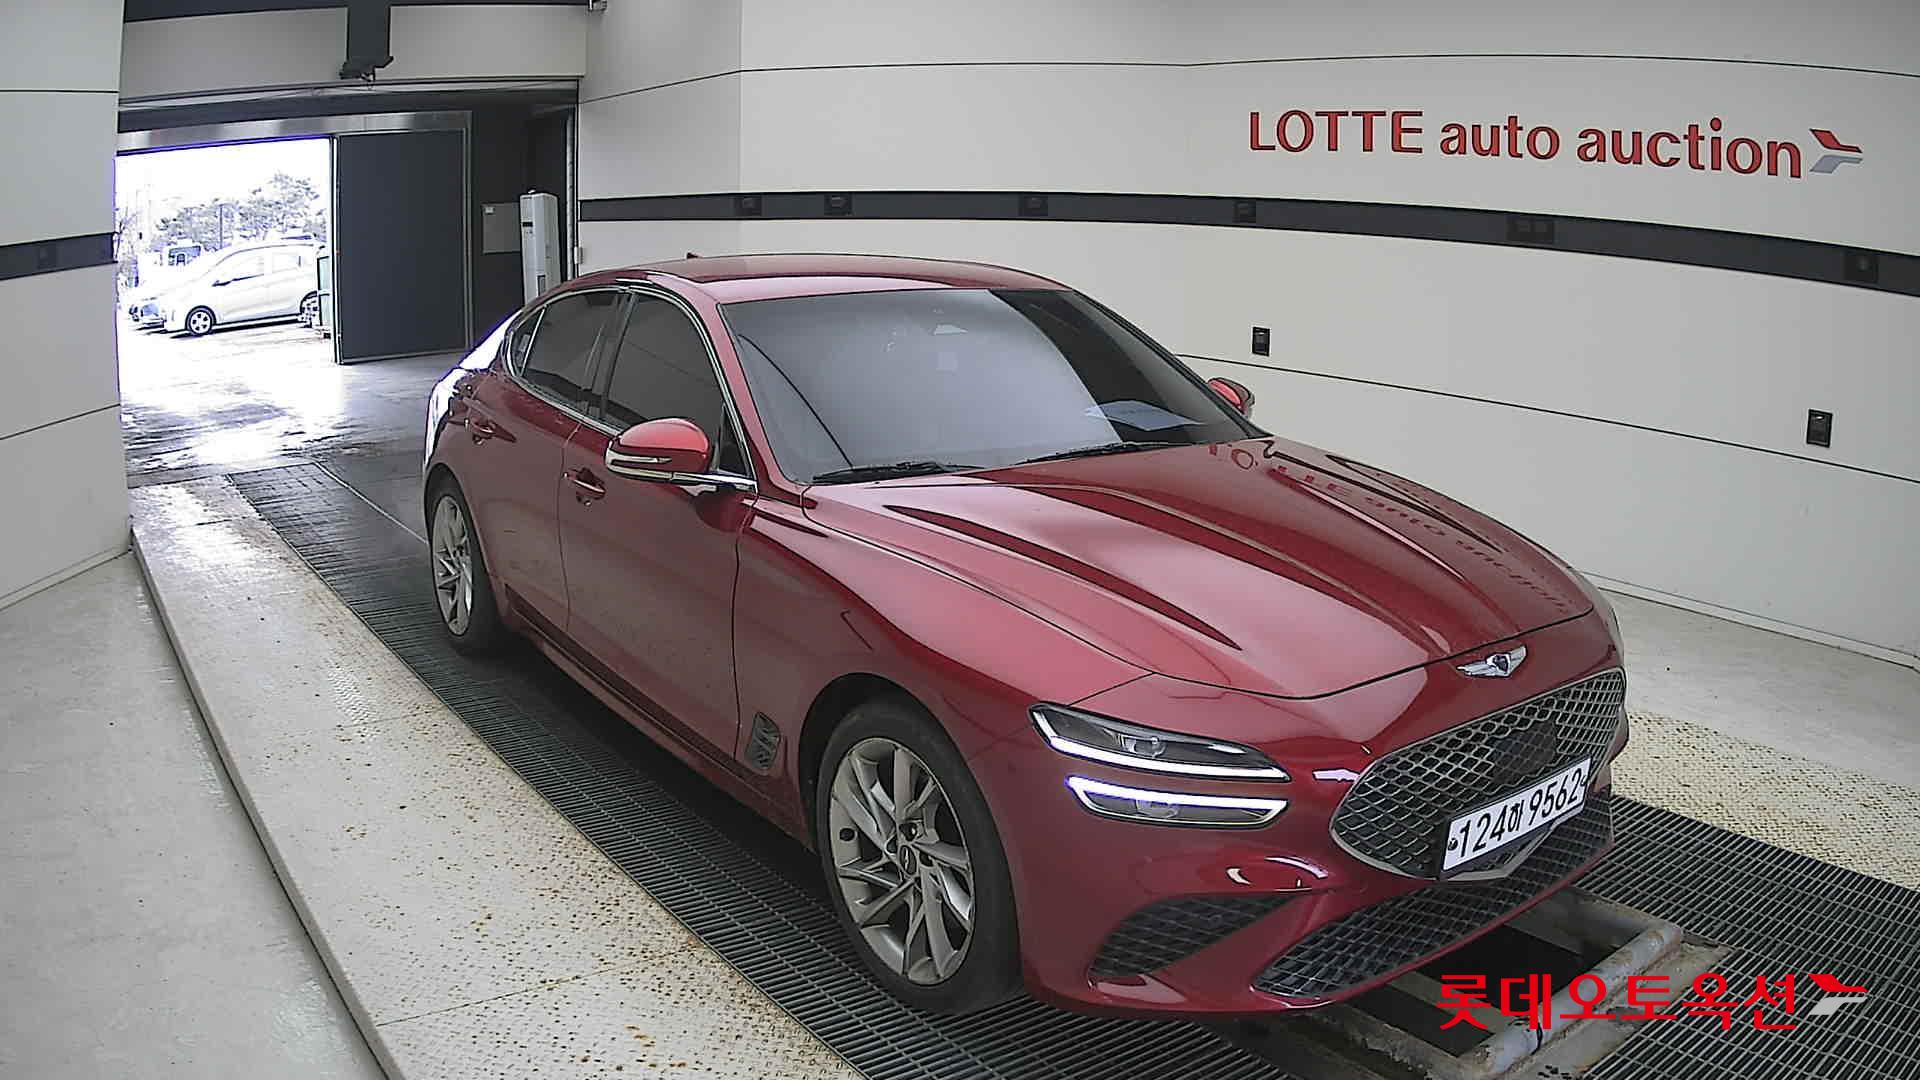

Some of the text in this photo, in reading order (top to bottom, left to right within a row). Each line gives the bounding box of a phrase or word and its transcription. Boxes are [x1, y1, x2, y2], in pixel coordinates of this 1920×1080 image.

[1249, 110, 1802, 179] LOTTE auto auction
